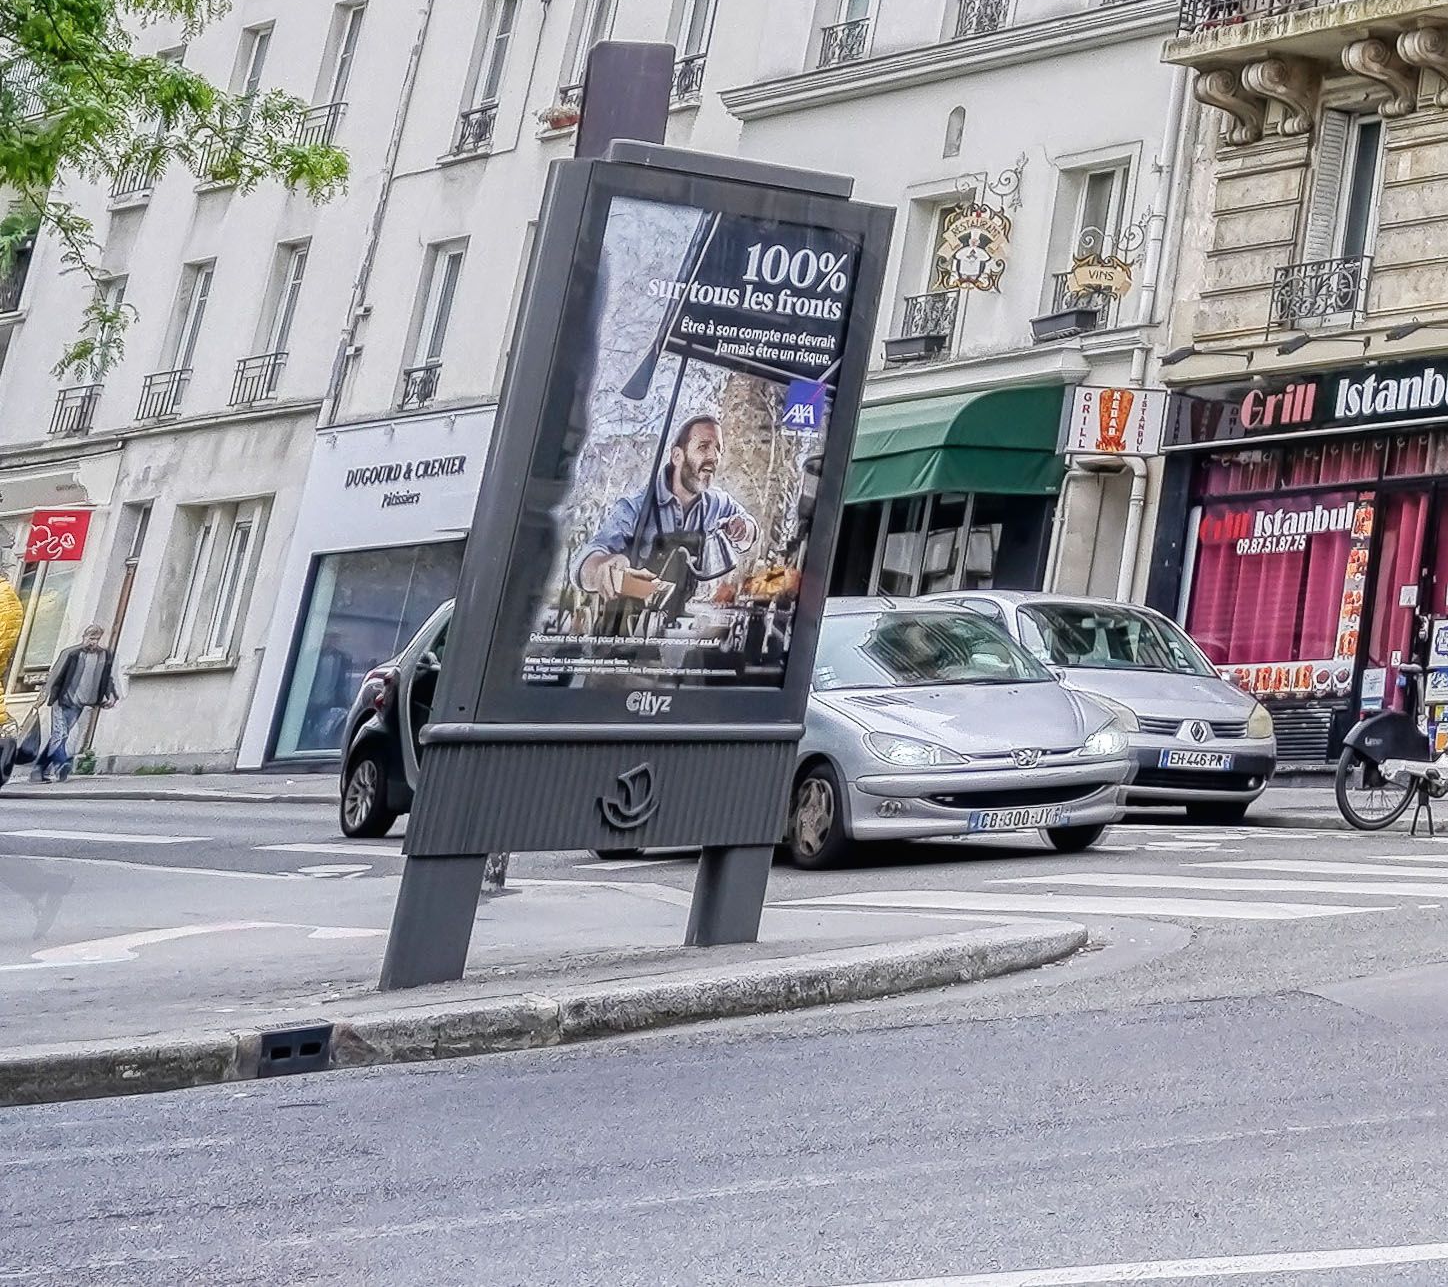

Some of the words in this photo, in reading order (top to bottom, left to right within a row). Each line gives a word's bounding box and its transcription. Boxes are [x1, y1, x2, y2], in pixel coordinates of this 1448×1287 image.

[742, 242, 847, 293] 100%
[1088, 269, 1114, 281] VINS
[647, 278, 687, 300] sur
[689, 281, 740, 309] tous
[742, 285, 774, 313] les
[777, 288, 842, 320] fronts
[707, 320, 715, 334] à
[716, 323, 738, 338] son
[738, 326, 781, 344] compte
[782, 331, 798, 344] ne
[798, 332, 835, 349] devrait
[715, 339, 754, 357] jamais
[755, 344, 778, 360] être
[780, 348, 794, 361] un
[796, 348, 832, 366] risque.
[782, 403, 815, 425] AXA
[1078, 392, 1093, 448] GRILL
[1108, 391, 1121, 436] KEBAB
[1136, 393, 1148, 452] ISTANBUL
[1240, 382, 1318, 429] Grill
[345, 463, 401, 489] DUGOURD
[403, 461, 412, 481] &
[415, 455, 467, 479] CRENIER
[1254, 501, 1356, 538] Istanbul
